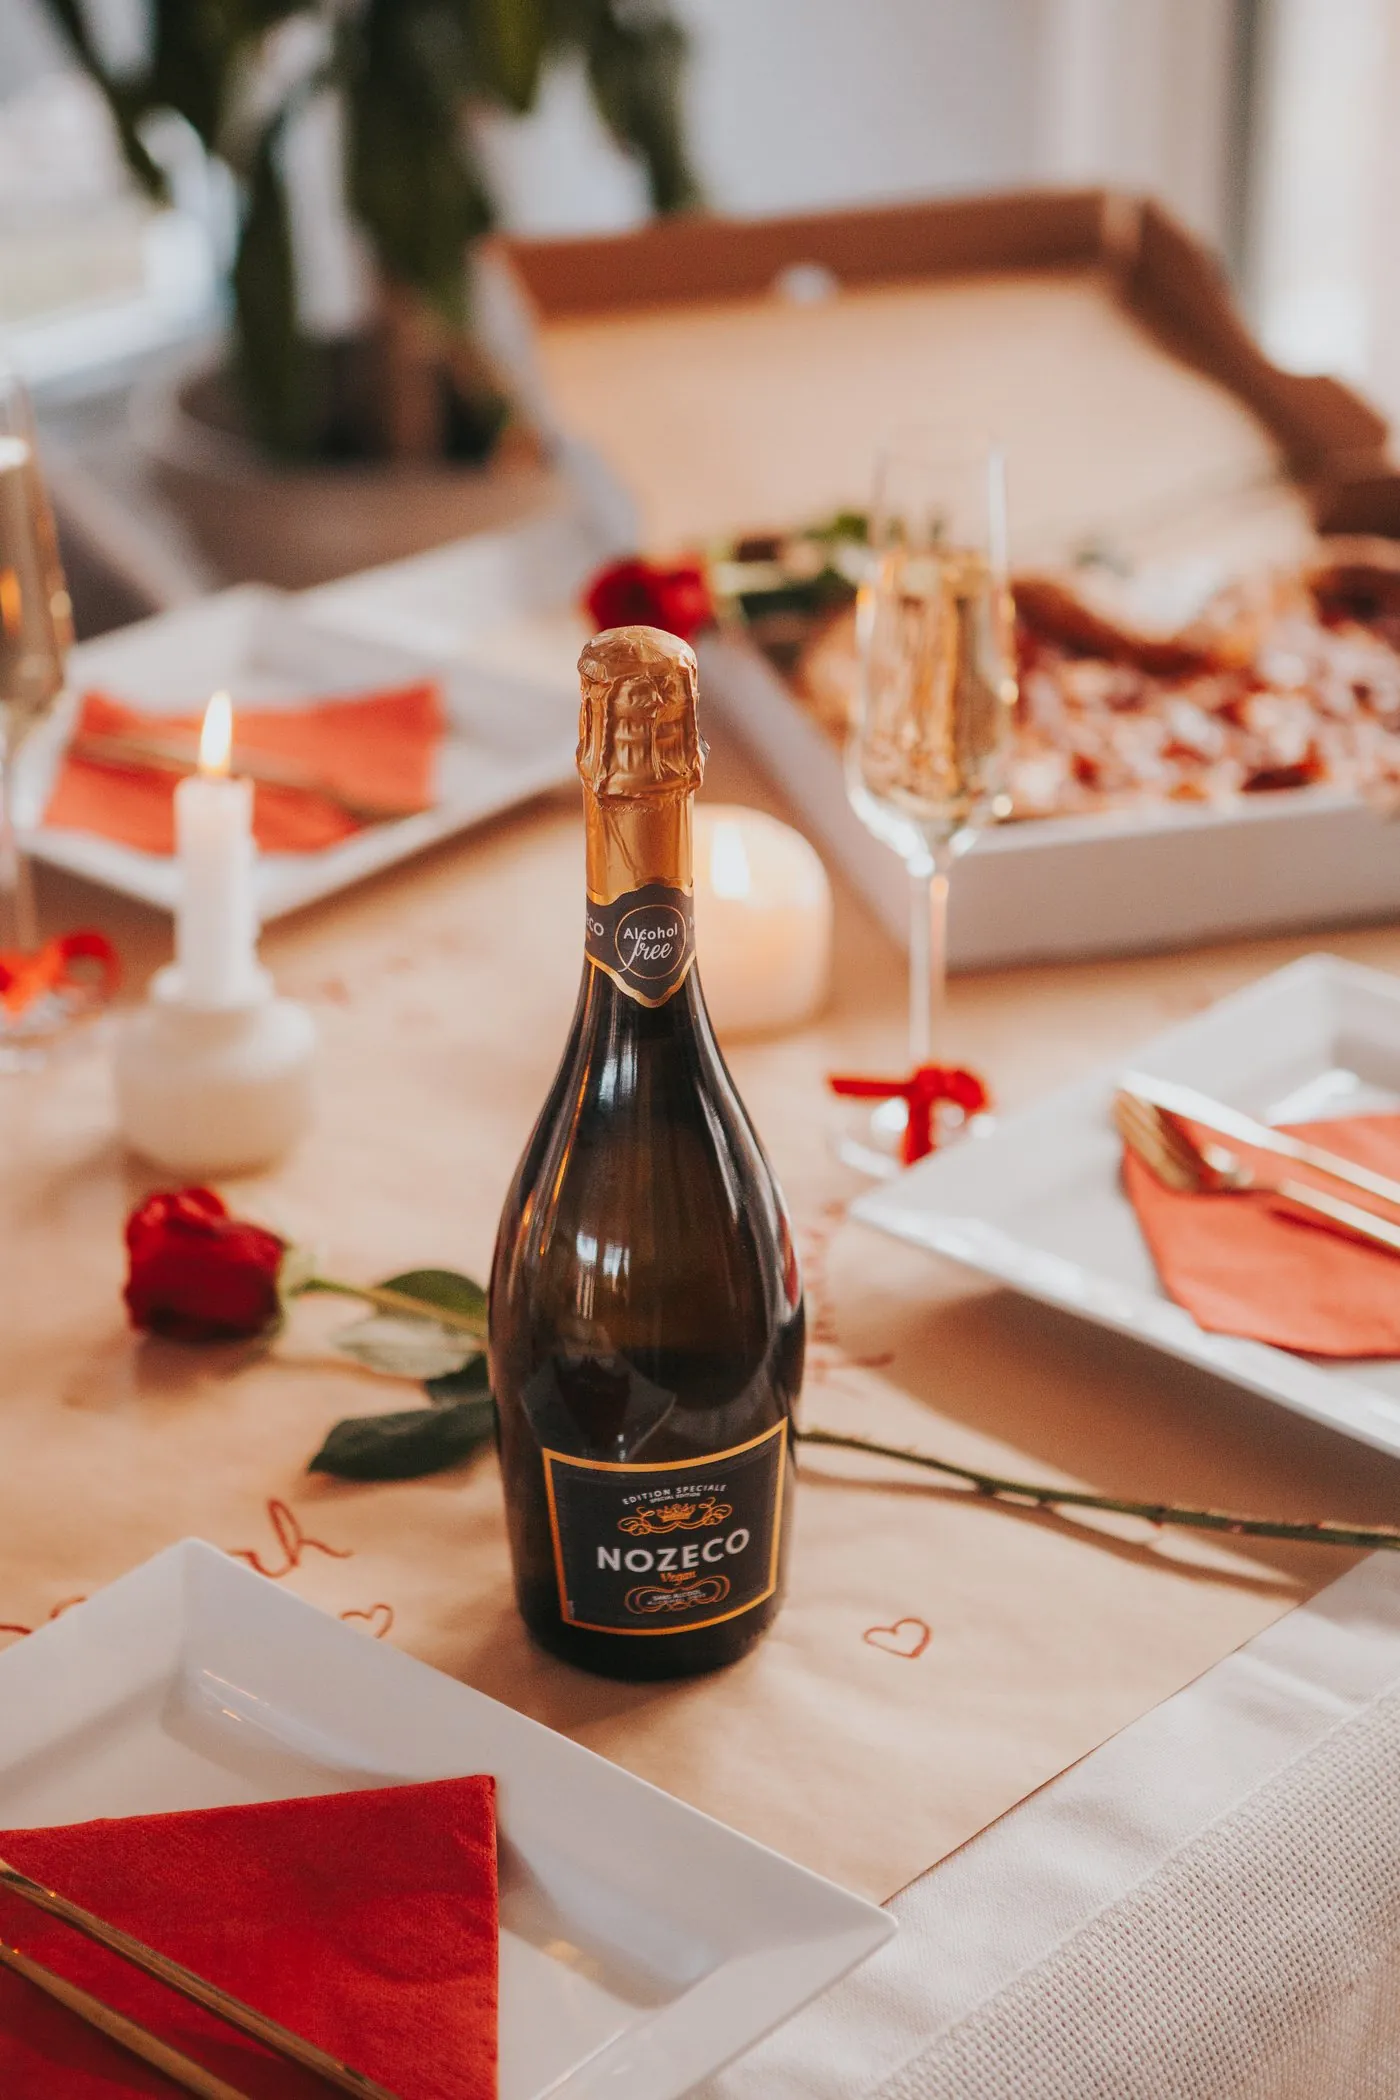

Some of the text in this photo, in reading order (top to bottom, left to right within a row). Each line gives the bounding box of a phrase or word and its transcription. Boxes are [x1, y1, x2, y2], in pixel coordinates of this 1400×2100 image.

[623, 923, 678, 941] Alcohol
[617, 931, 674, 973] free
[622, 1484, 727, 1505] EDITION SPECIALE
[597, 1528, 750, 1573] NOZECO
[660, 1571, 697, 1586] Vegan
